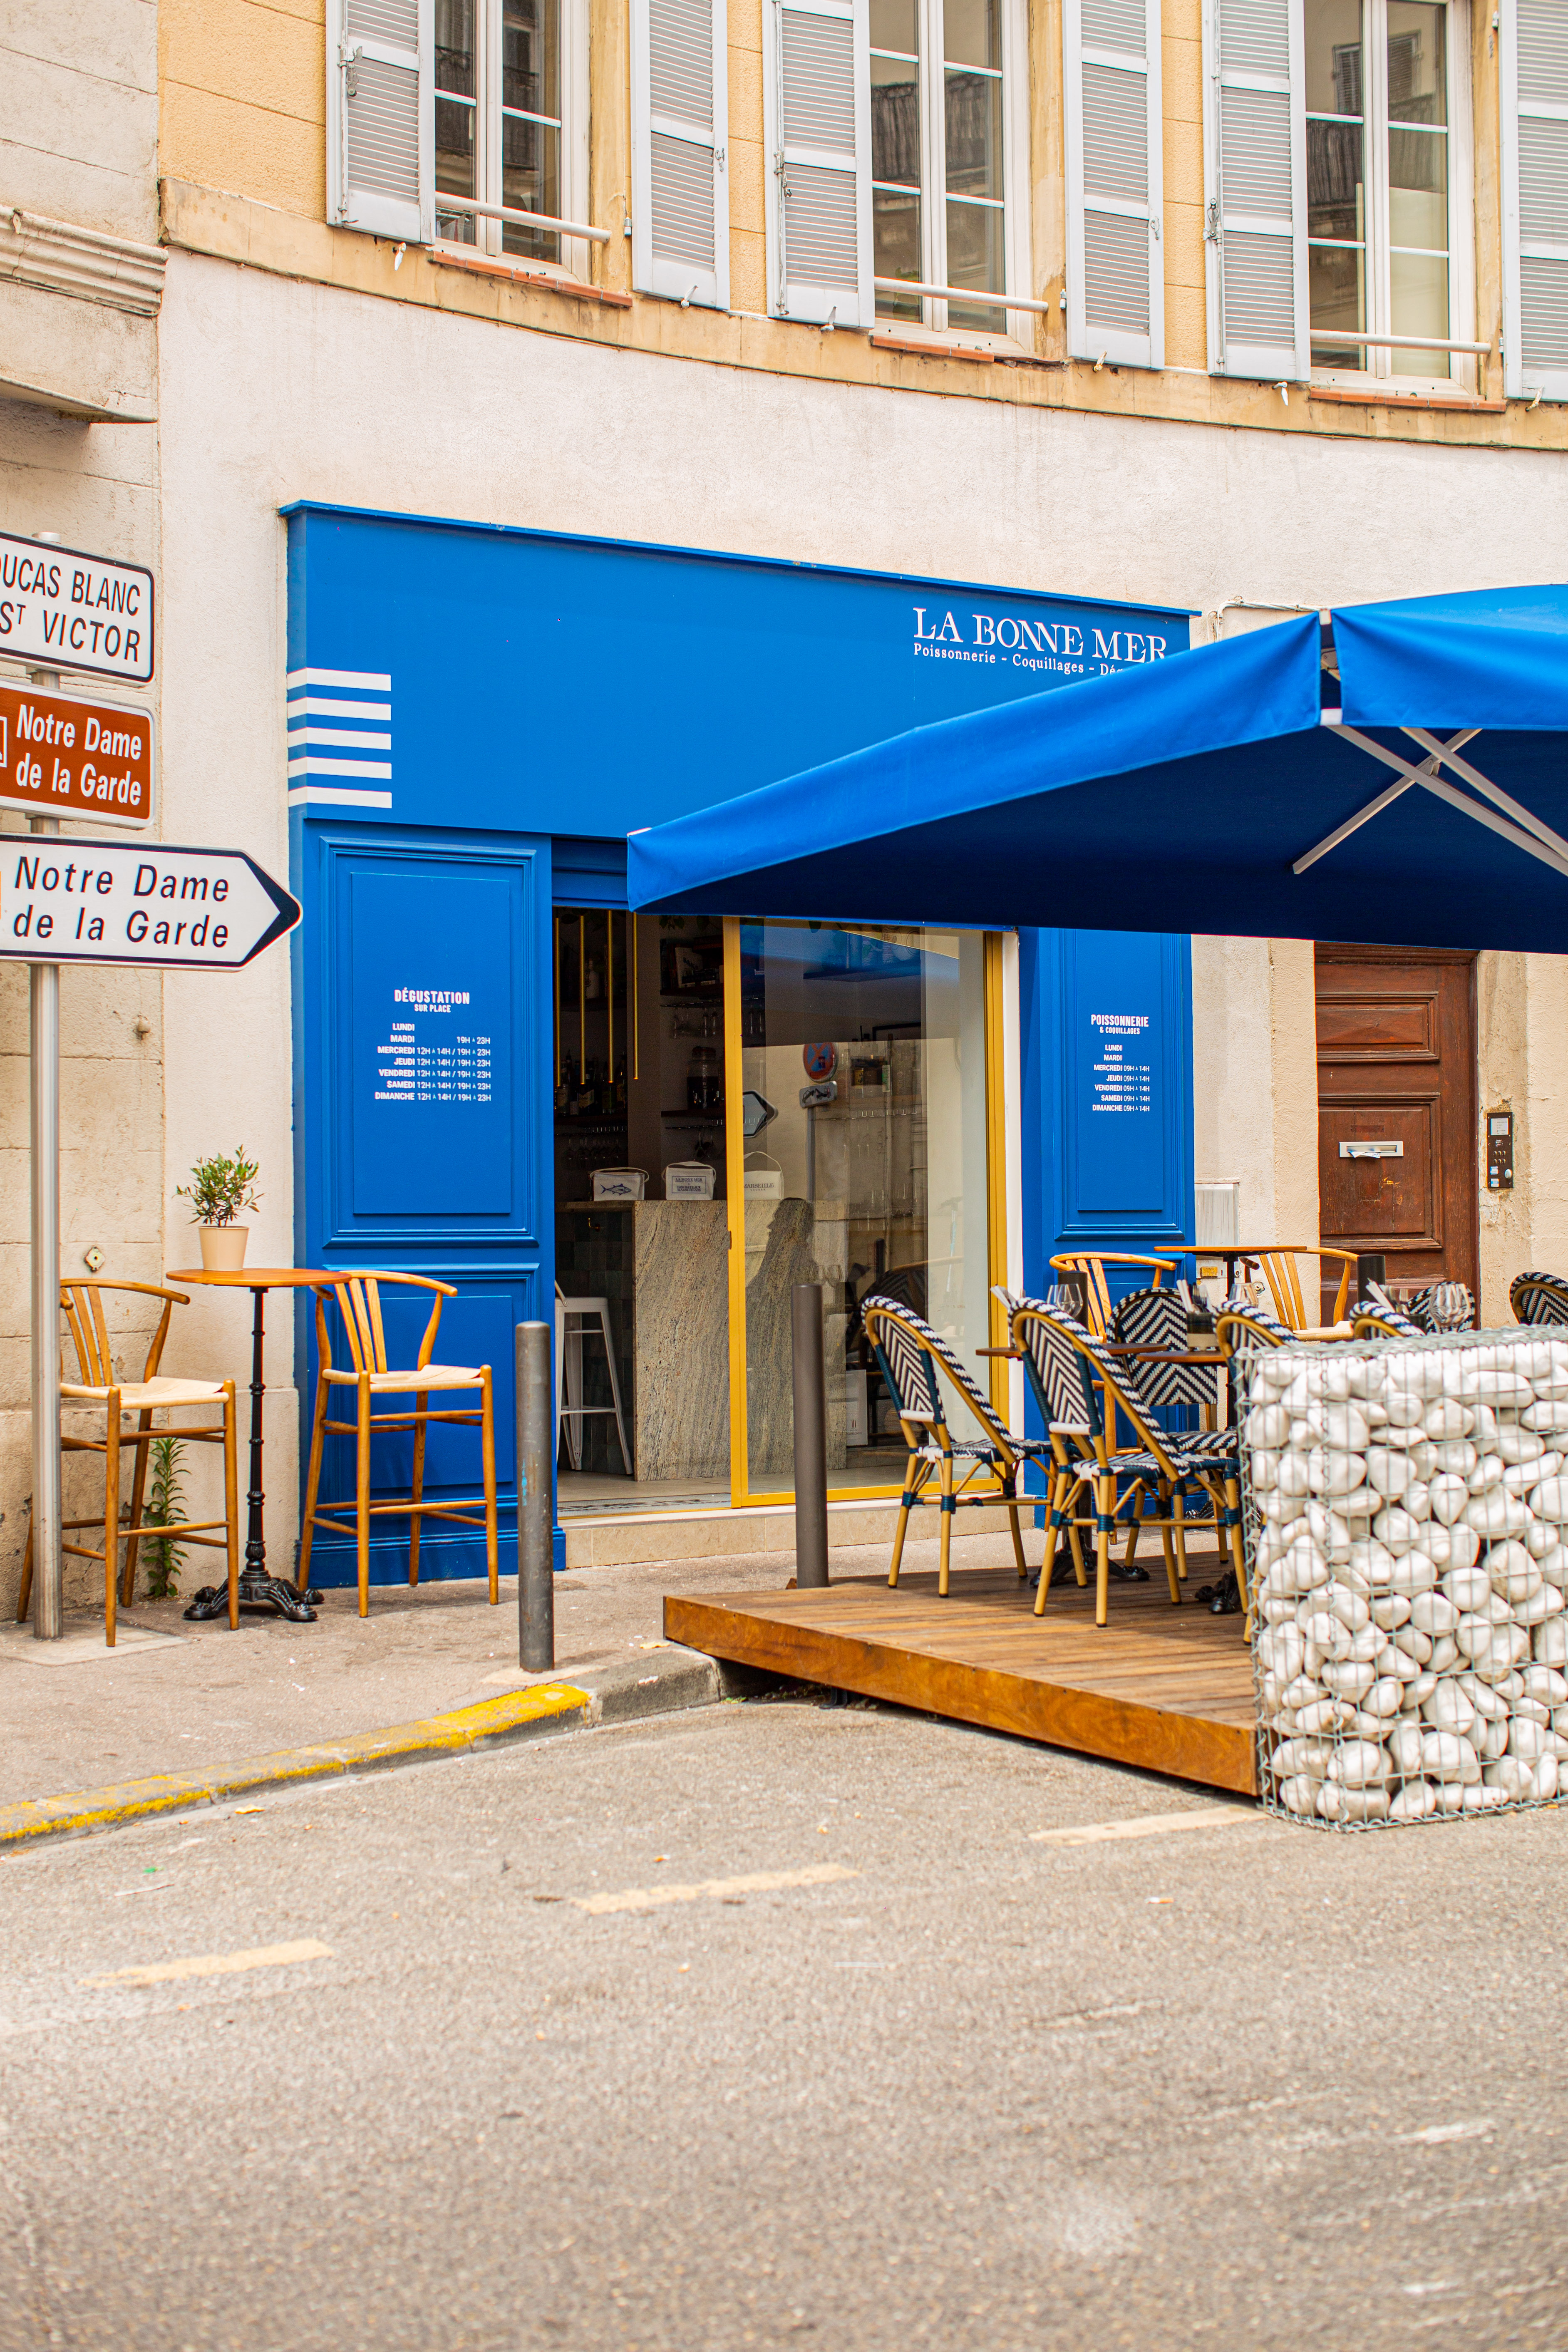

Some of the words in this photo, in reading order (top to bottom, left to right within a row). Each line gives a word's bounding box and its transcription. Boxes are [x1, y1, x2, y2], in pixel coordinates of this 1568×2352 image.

[0, 554, 61, 598] UCAS
[72, 570, 140, 616] BLANC
[43, 610, 140, 662] VICTOR
[913, 607, 964, 643] LA
[972, 614, 1084, 656] BONNE
[1092, 628, 1166, 664] MER
[914, 642, 996, 663] Poissonnerie
[1012, 653, 1084, 675] Coquillages
[1100, 663, 1124, 675] Dé
[16, 704, 75, 748] Notre
[84, 717, 142, 760] Dame
[15, 752, 42, 789] de
[52, 757, 71, 794] la
[80, 763, 141, 806] Garde
[15, 856, 113, 895] Notre
[134, 864, 228, 902] Dame
[13, 905, 53, 938] de
[75, 907, 105, 940] la
[127, 910, 228, 948] Garde
[394, 987, 470, 1004] DÉGUSTATION
[429, 1004, 451, 1012] PLACE
[392, 1023, 415, 1031] LUNDI
[1091, 1014, 1149, 1027] POISSONNERIE
[377, 1046, 415, 1054] MERCREDI
[390, 1035, 414, 1043] MARDI
[378, 1069, 415, 1077] VENDREDI
[375, 1092, 414, 1100] DIMANCHE
